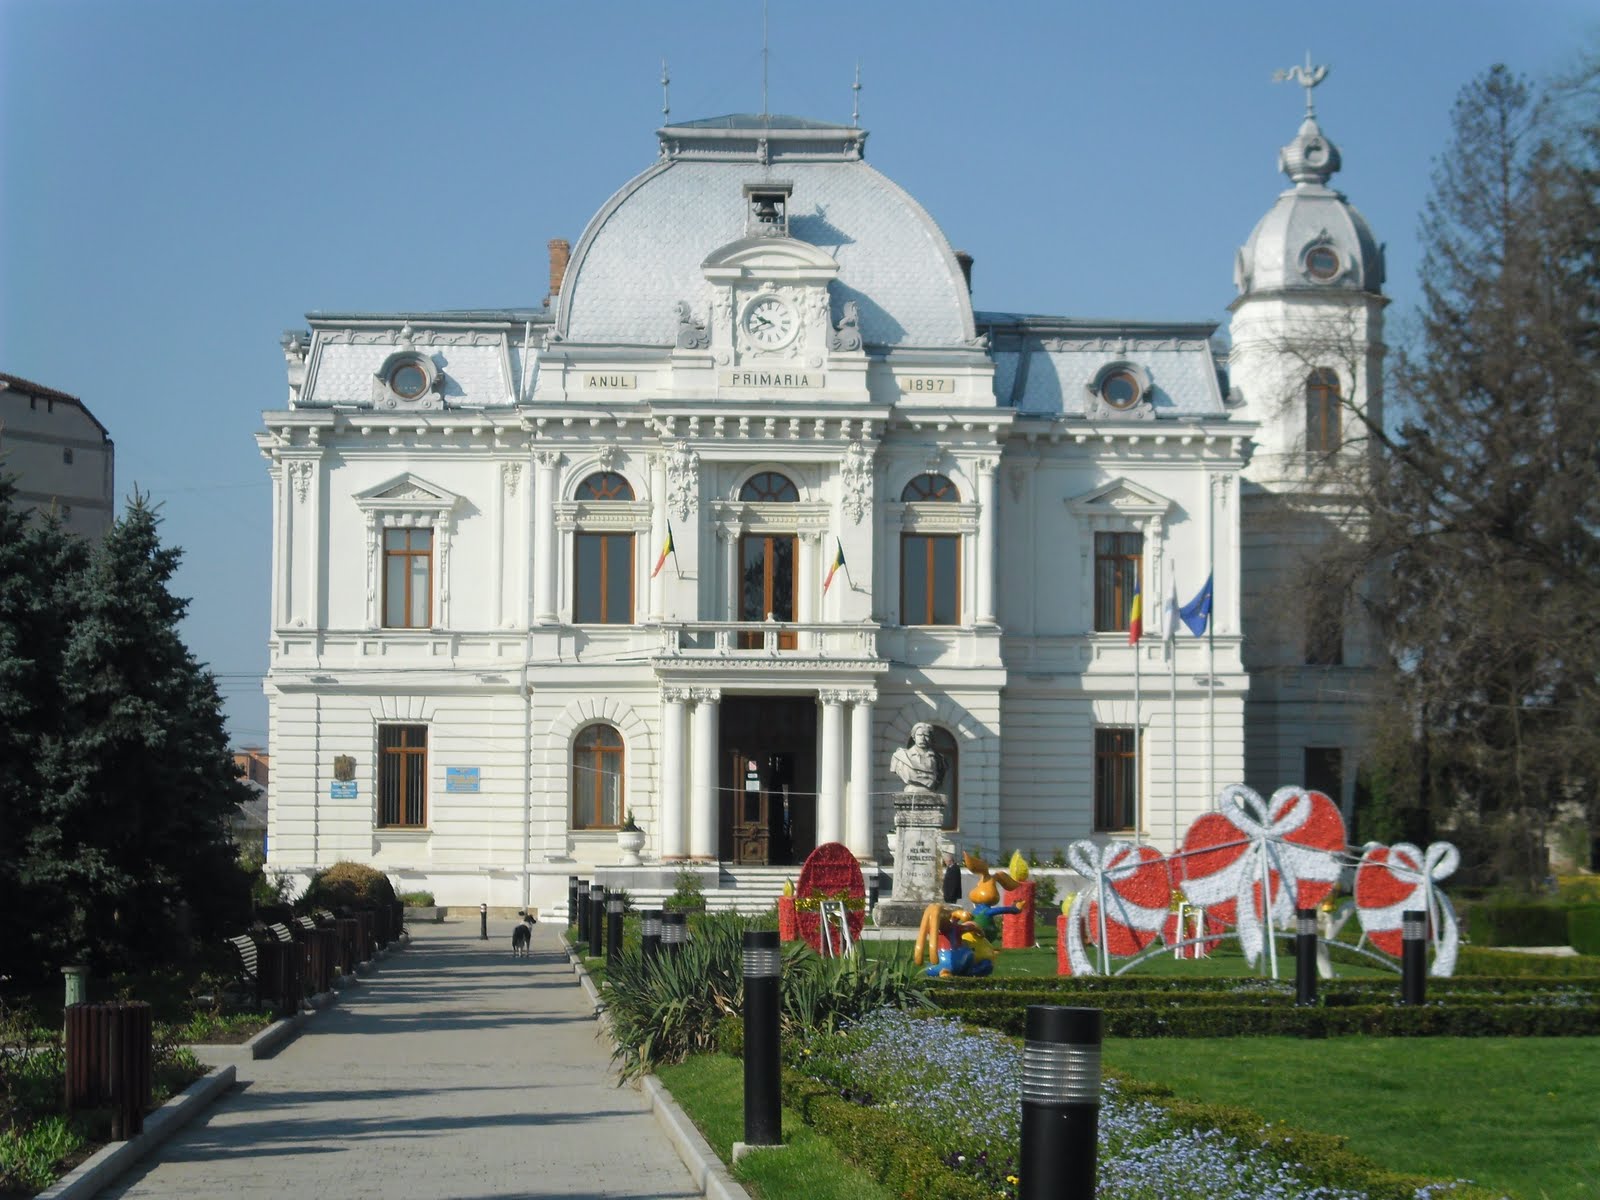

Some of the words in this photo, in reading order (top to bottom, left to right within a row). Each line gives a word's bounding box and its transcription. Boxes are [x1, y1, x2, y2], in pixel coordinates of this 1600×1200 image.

[589, 376, 629, 387] ANUL
[732, 373, 809, 387] PRIMARIA
[909, 379, 945, 391] 1897
